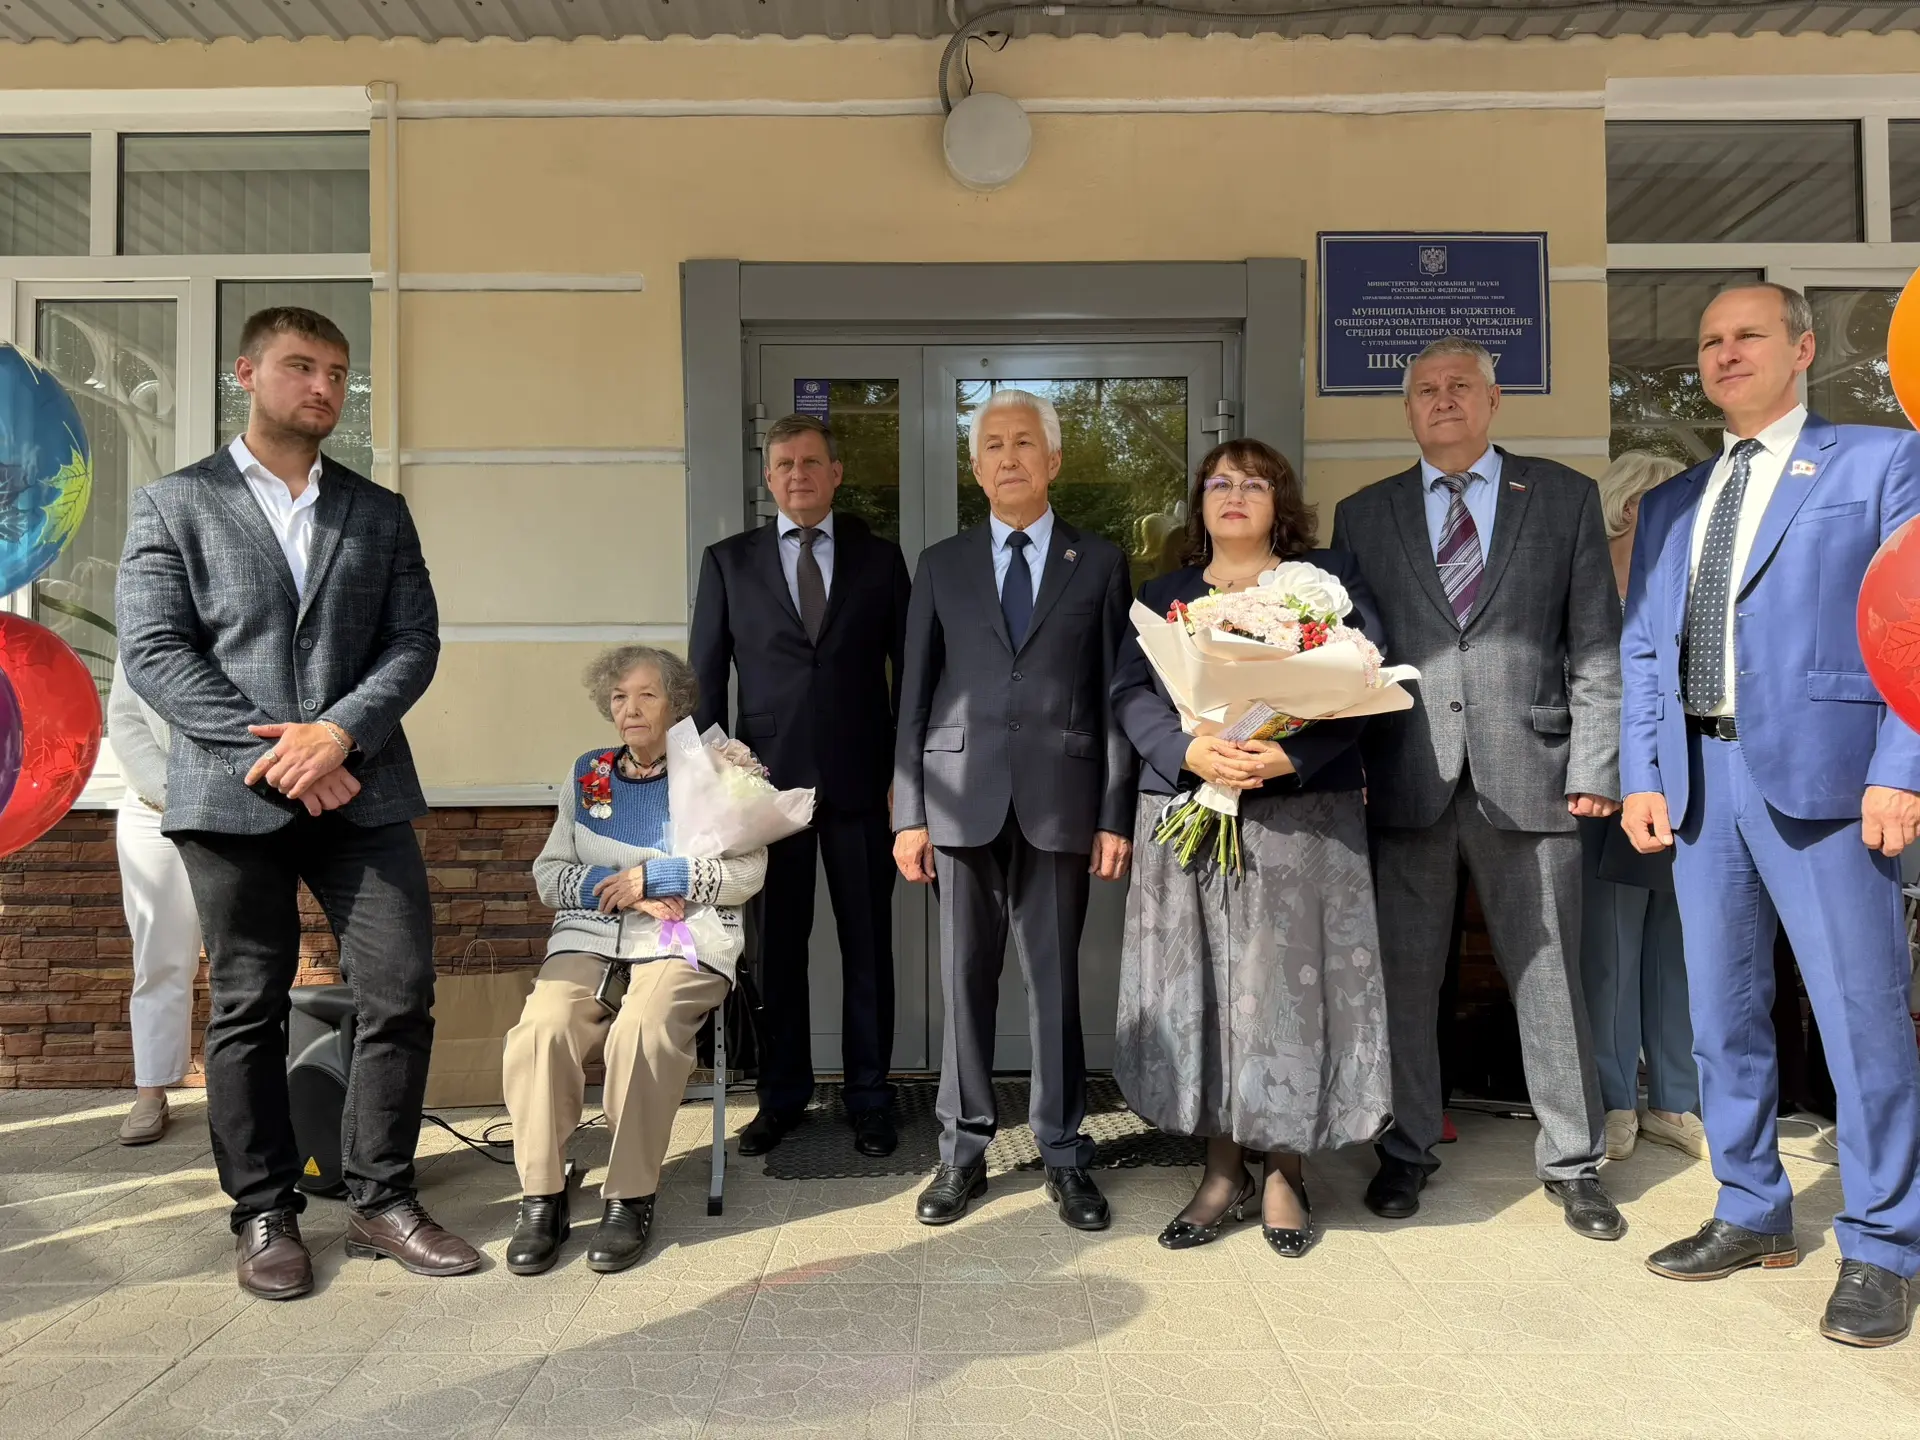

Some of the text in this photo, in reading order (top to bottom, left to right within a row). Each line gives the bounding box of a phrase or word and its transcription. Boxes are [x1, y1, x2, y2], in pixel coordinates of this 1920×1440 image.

[1352, 307, 1516, 317] МУНИЦИПАЛЬНОЕ БЮДЖЕТНОЕ
[1334, 317, 1533, 327] ОБЩЕОБРАЗОВАТЕЛЬНОЕ УЧРЕЖДЕНИЕ
[1345, 328, 1522, 337] СРЕДНЯЯ ОБЩЕОБРАЗОВАТЕЛЬНАЯ
[1367, 353, 1418, 369] ШКО
